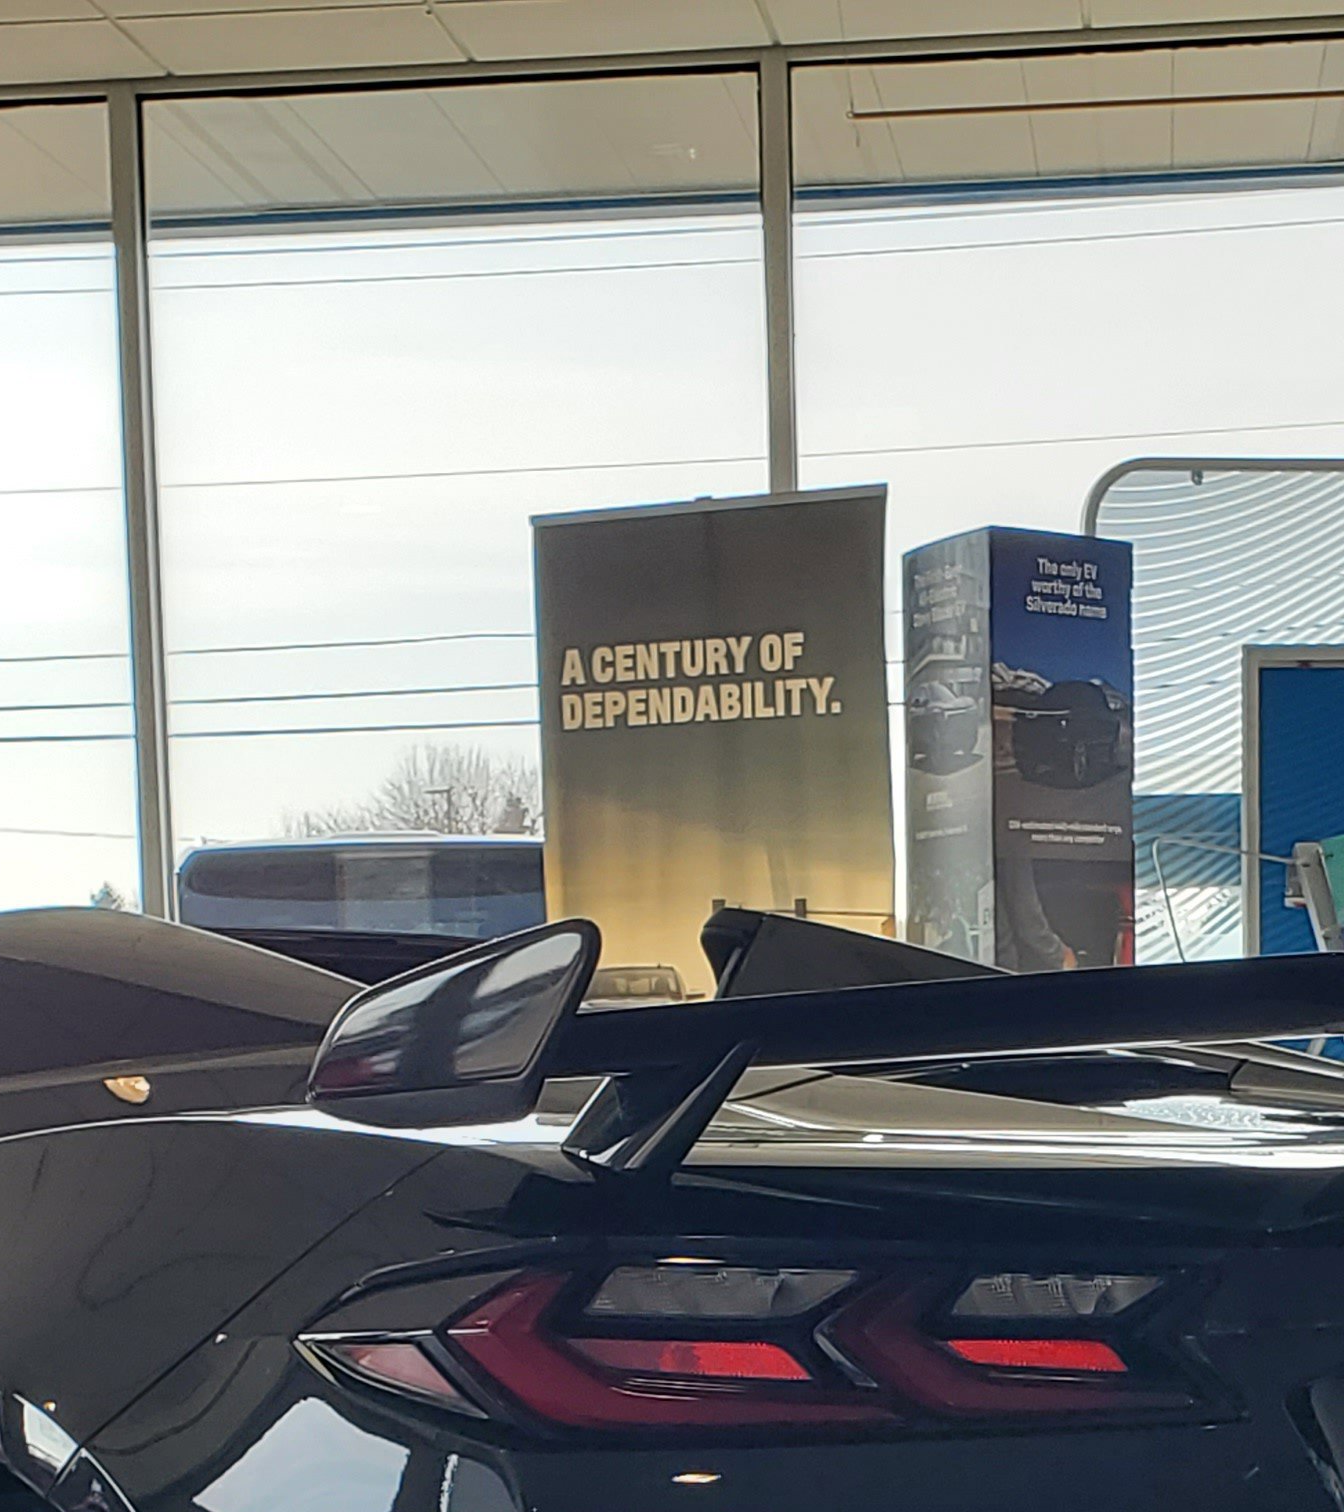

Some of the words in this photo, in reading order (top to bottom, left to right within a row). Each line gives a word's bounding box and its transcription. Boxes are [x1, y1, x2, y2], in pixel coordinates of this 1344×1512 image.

[1037, 557, 1058, 575] The
[1060, 560, 1082, 580] only
[1083, 563, 1098, 580] EV
[1032, 579, 1071, 598] worthy
[1072, 582, 1084, 597] of
[1085, 583, 1102, 600] the
[1026, 595, 1077, 616] Silverado
[561, 648, 586, 686] A
[592, 636, 752, 683] CENTURY
[759, 632, 804, 672] OF
[561, 677, 842, 731] DEPENDABILITY.
